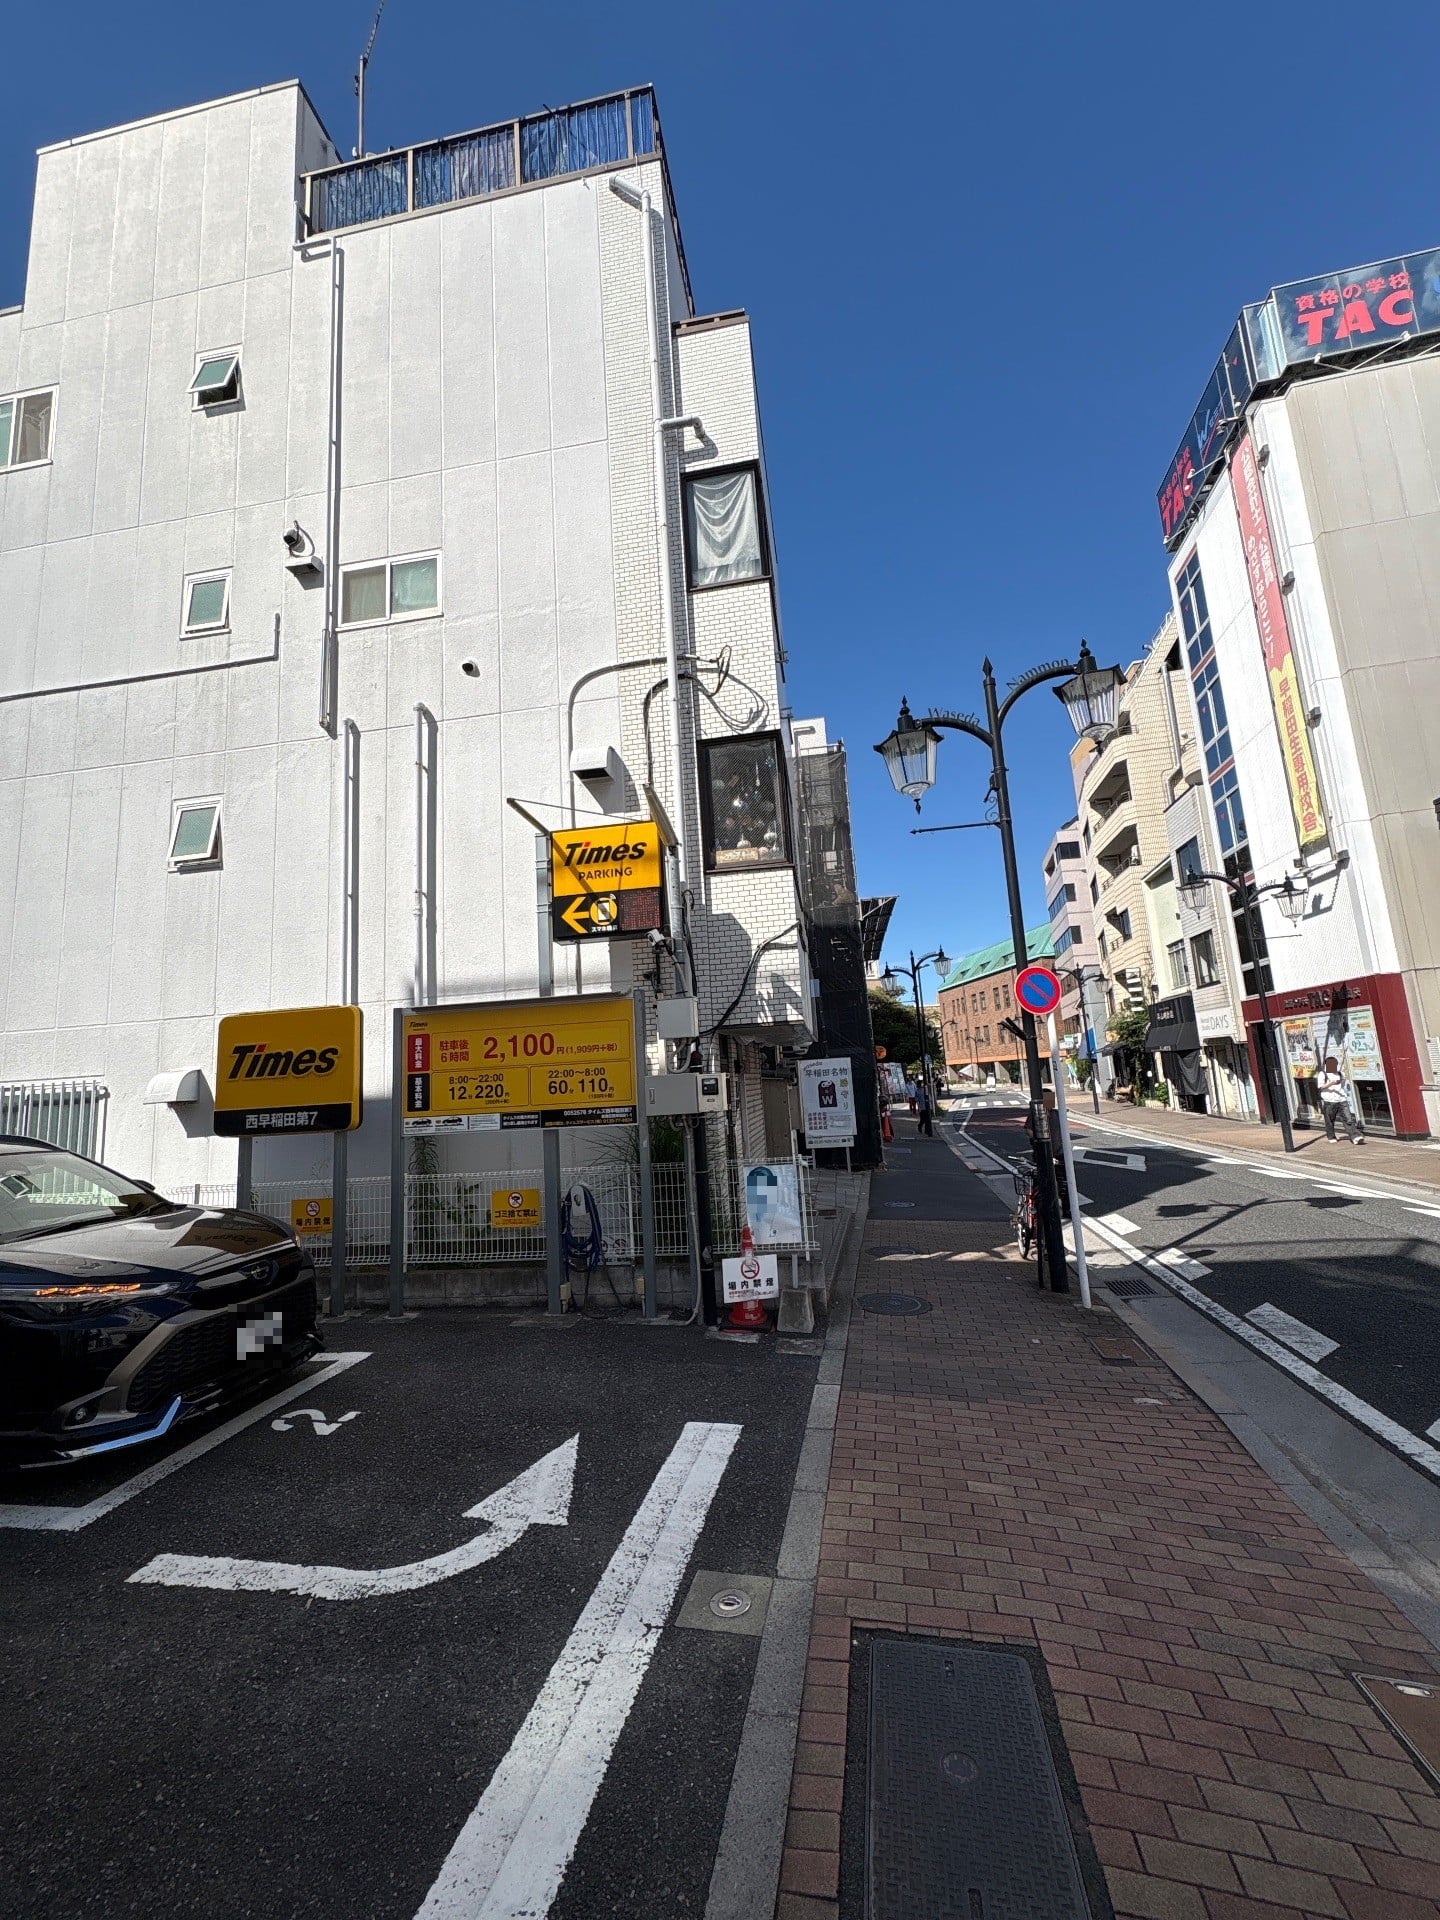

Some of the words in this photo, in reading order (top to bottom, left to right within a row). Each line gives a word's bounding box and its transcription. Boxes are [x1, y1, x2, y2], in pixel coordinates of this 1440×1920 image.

[1295, 272, 1410, 311] 資格の学校
[1298, 289, 1414, 346] TAC
[1279, 676, 1317, 833] 早稲田生専用校舎
[563, 841, 648, 866] Times
[579, 867, 633, 880] PARKING
[1210, 1015, 1230, 1030] DAYS
[440, 1040, 469, 1051] 駐車後
[228, 1043, 339, 1079] Times
[441, 1051, 469, 1062] 6時間
[804, 1067, 849, 1078] 早稲田名物
[415, 1077, 423, 1108] 基本料金
[245, 1111, 319, 1129] 西早稲田第7
[494, 1208, 539, 1219] ゴミ捨て禁止
[728, 1277, 774, 1290] 場内禁煙
